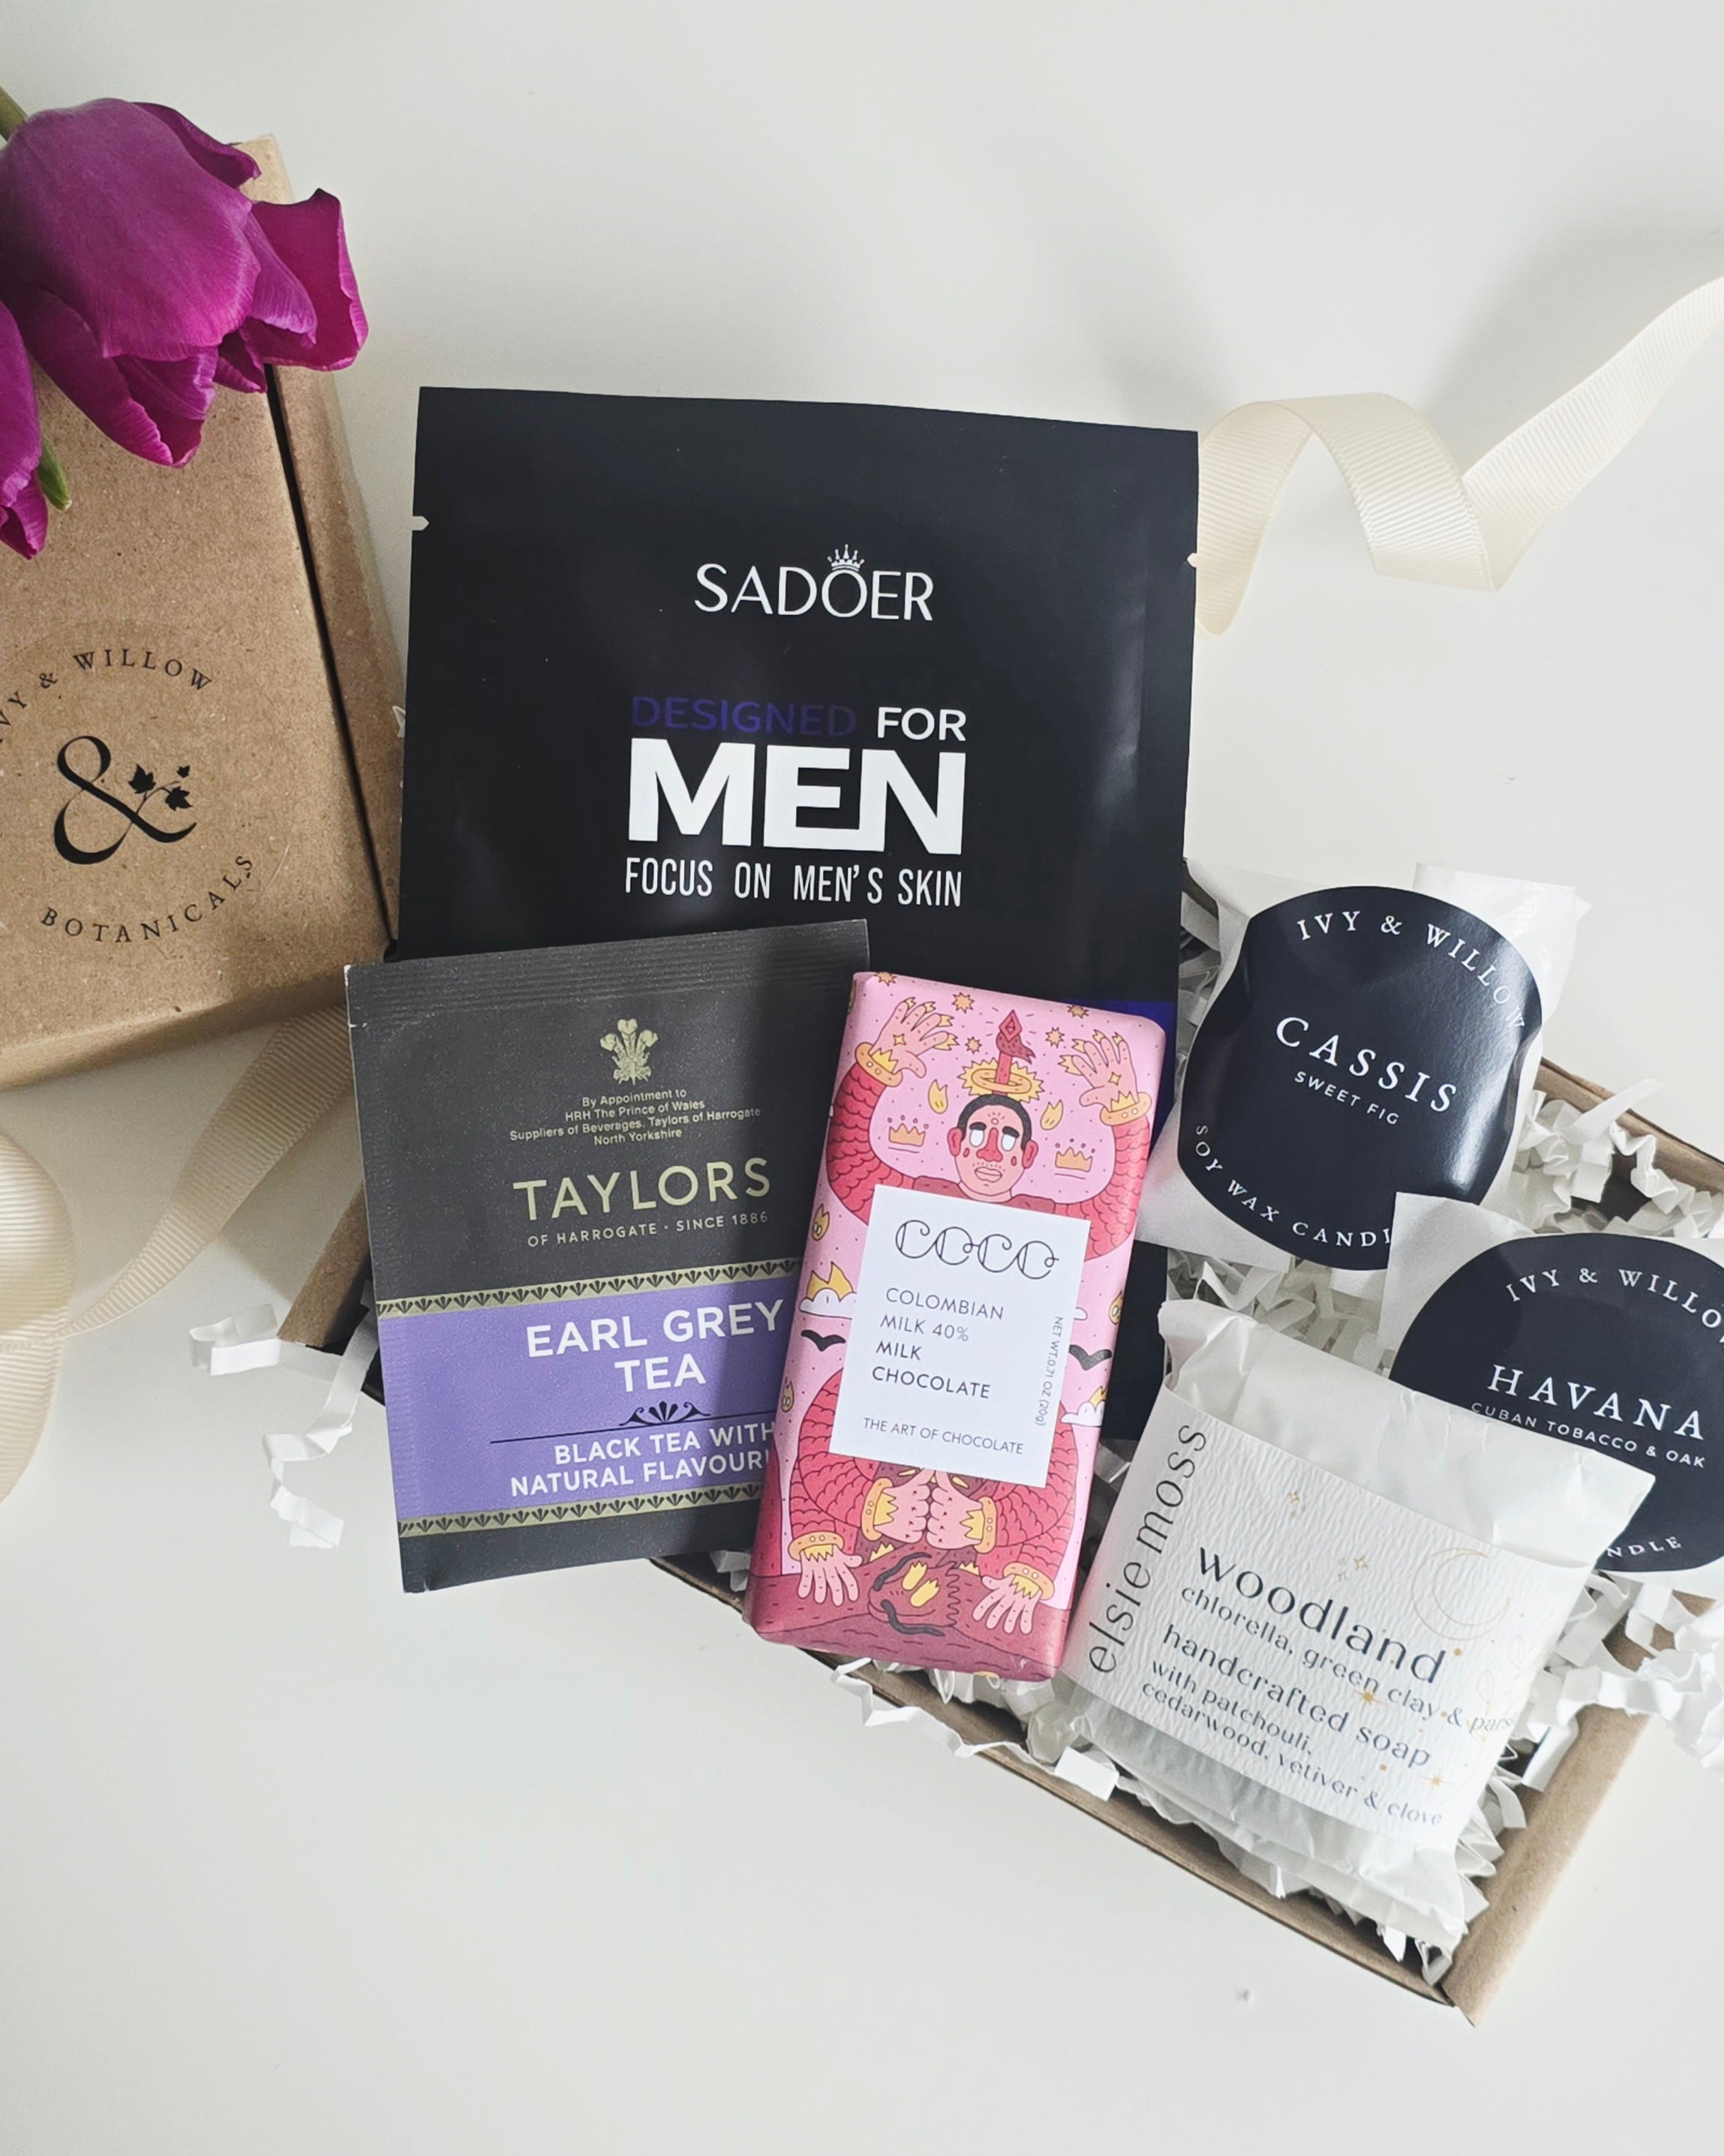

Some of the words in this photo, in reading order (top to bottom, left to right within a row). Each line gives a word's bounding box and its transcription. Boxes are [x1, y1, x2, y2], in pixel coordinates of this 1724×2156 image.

[695, 563, 933, 621] SADOER
[39, 672, 58, 689] &
[73, 649, 212, 691] WILLOW
[631, 695, 857, 737] DESIGNED
[877, 707, 966, 742] FOR
[628, 737, 966, 854] MEN
[41, 855, 254, 943] BOTANICALS
[625, 857, 713, 897] FOCUS
[734, 863, 771, 899] ON
[793, 864, 884, 904] MEN'S
[897, 868, 962, 907] SKIN
[1296, 910, 1361, 941] IVY
[1380, 915, 1402, 935] &
[1427, 923, 1525, 1028] WILLOW
[1275, 1016, 1457, 1113] CASSIS
[565, 1110, 591, 1122] HRH
[593, 1107, 616, 1119] The
[619, 1105, 656, 1118] Prince
[657, 1103, 670, 1113] of
[671, 1098, 705, 1111] Wales
[581, 1097, 597, 1110] By
[599, 1089, 673, 1108] Appointment
[675, 1089, 687, 1099] to
[1294, 1071, 1362, 1108] SWEET
[1366, 1103, 1400, 1125] FIG
[510, 1127, 565, 1141] Suppliers
[567, 1125, 579, 1136] of
[648, 1114, 689, 1130] Taylors
[692, 1112, 704, 1122] of
[705, 1107, 761, 1122] Harrogate
[593, 1133, 626, 1146] North
[628, 1128, 683, 1143] Yorkshire
[512, 1157, 770, 1221] TAYLORS
[1195, 1125, 1223, 1173] SOY
[1227, 1179, 1280, 1223] WAX
[1292, 1221, 1392, 1247] CAND
[527, 1234, 548, 1247] OF
[557, 1223, 658, 1244] HARROGATE
[676, 1215, 724, 1233] SINCE
[731, 1211, 768, 1226] 1886
[885, 1287, 1004, 1320] COLOMBIAN
[1052, 1316, 1064, 1338] NET
[1506, 1269, 1558, 1302] IVY
[1578, 1268, 1598, 1284] &
[1618, 1269, 1724, 1350] WILLO
[526, 1316, 648, 1358] EARL
[663, 1299, 784, 1342] GREY
[875, 1341, 922, 1361] MILK
[880, 1314, 926, 1335] MILK
[932, 1323, 969, 1342] 40%
[614, 1353, 707, 1392] TEA
[872, 1365, 991, 1399] CHOCOLATE
[1041, 1380, 1053, 1397] OZ
[1034, 1399, 1050, 1426] (20g)
[1487, 1363, 1704, 1440] HAVANA
[554, 1437, 642, 1466] BLACK
[650, 1430, 701, 1456] TEA
[709, 1421, 775, 1447] WITH
[863, 1417, 888, 1432] THE
[890, 1422, 915, 1437] ART
[919, 1428, 939, 1440] OF
[942, 1431, 1024, 1455] CHOCOLATE
[1471, 1401, 1537, 1428] CUBAN
[1547, 1419, 1637, 1452] TOBACCO
[1644, 1445, 1657, 1458] &
[1665, 1449, 1706, 1469] OAK
[510, 1465, 634, 1497] NATURAL
[643, 1449, 769, 1482] FLAVOURI
[1088, 1560, 1152, 1674] elsie
[1135, 1425, 1207, 1554] moss
[1606, 1536, 1682, 1558] NDLE
[1199, 1545, 1446, 1684] woodland
[1152, 1659, 1197, 1695] with
[1181, 1584, 1294, 1656] chlorella,
[1304, 1648, 1380, 1694] green
[1388, 1688, 1440, 1721] clay
[1446, 1707, 1464, 1727] &
[1162, 1623, 1350, 1733] handcrafted
[1356, 1725, 1431, 1769] soap
[1277, 1752, 1359, 1800] vetiver
[1362, 1790, 1380, 1809] &
[1387, 1799, 1443, 1826] clove
